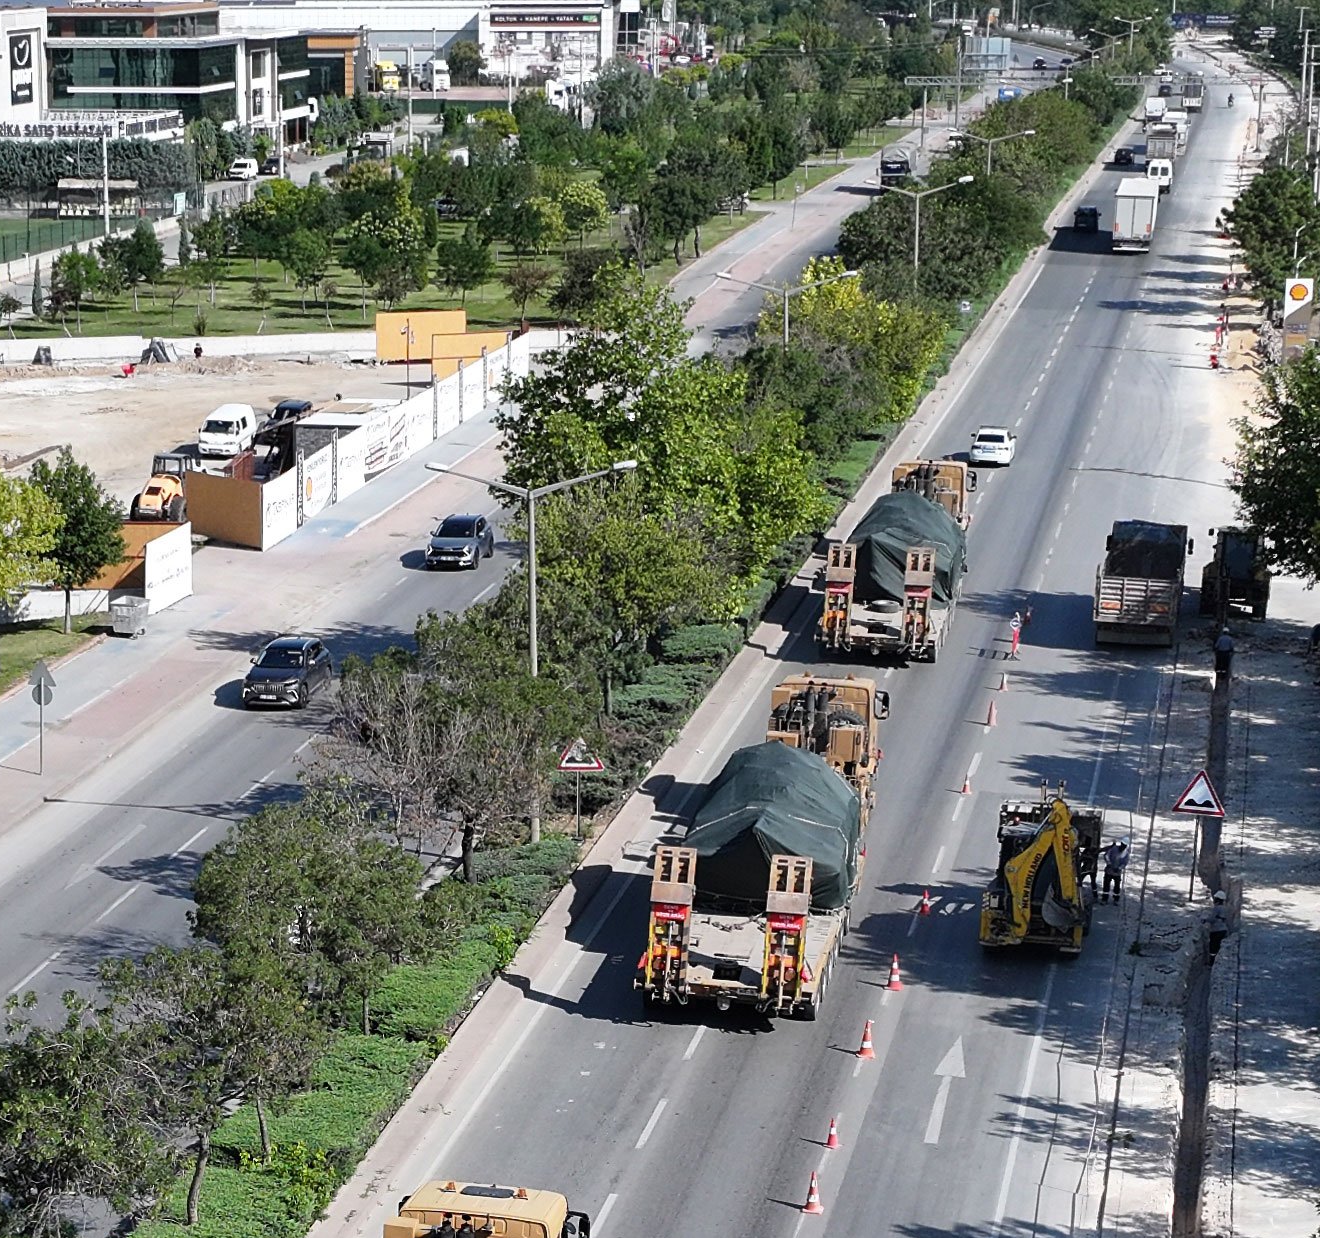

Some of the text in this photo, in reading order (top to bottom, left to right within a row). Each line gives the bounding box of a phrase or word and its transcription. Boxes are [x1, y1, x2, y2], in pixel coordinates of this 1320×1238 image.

[23, 124, 55, 140] SATIŞ
[1021, 853, 1043, 909] NEW HOLLAND
